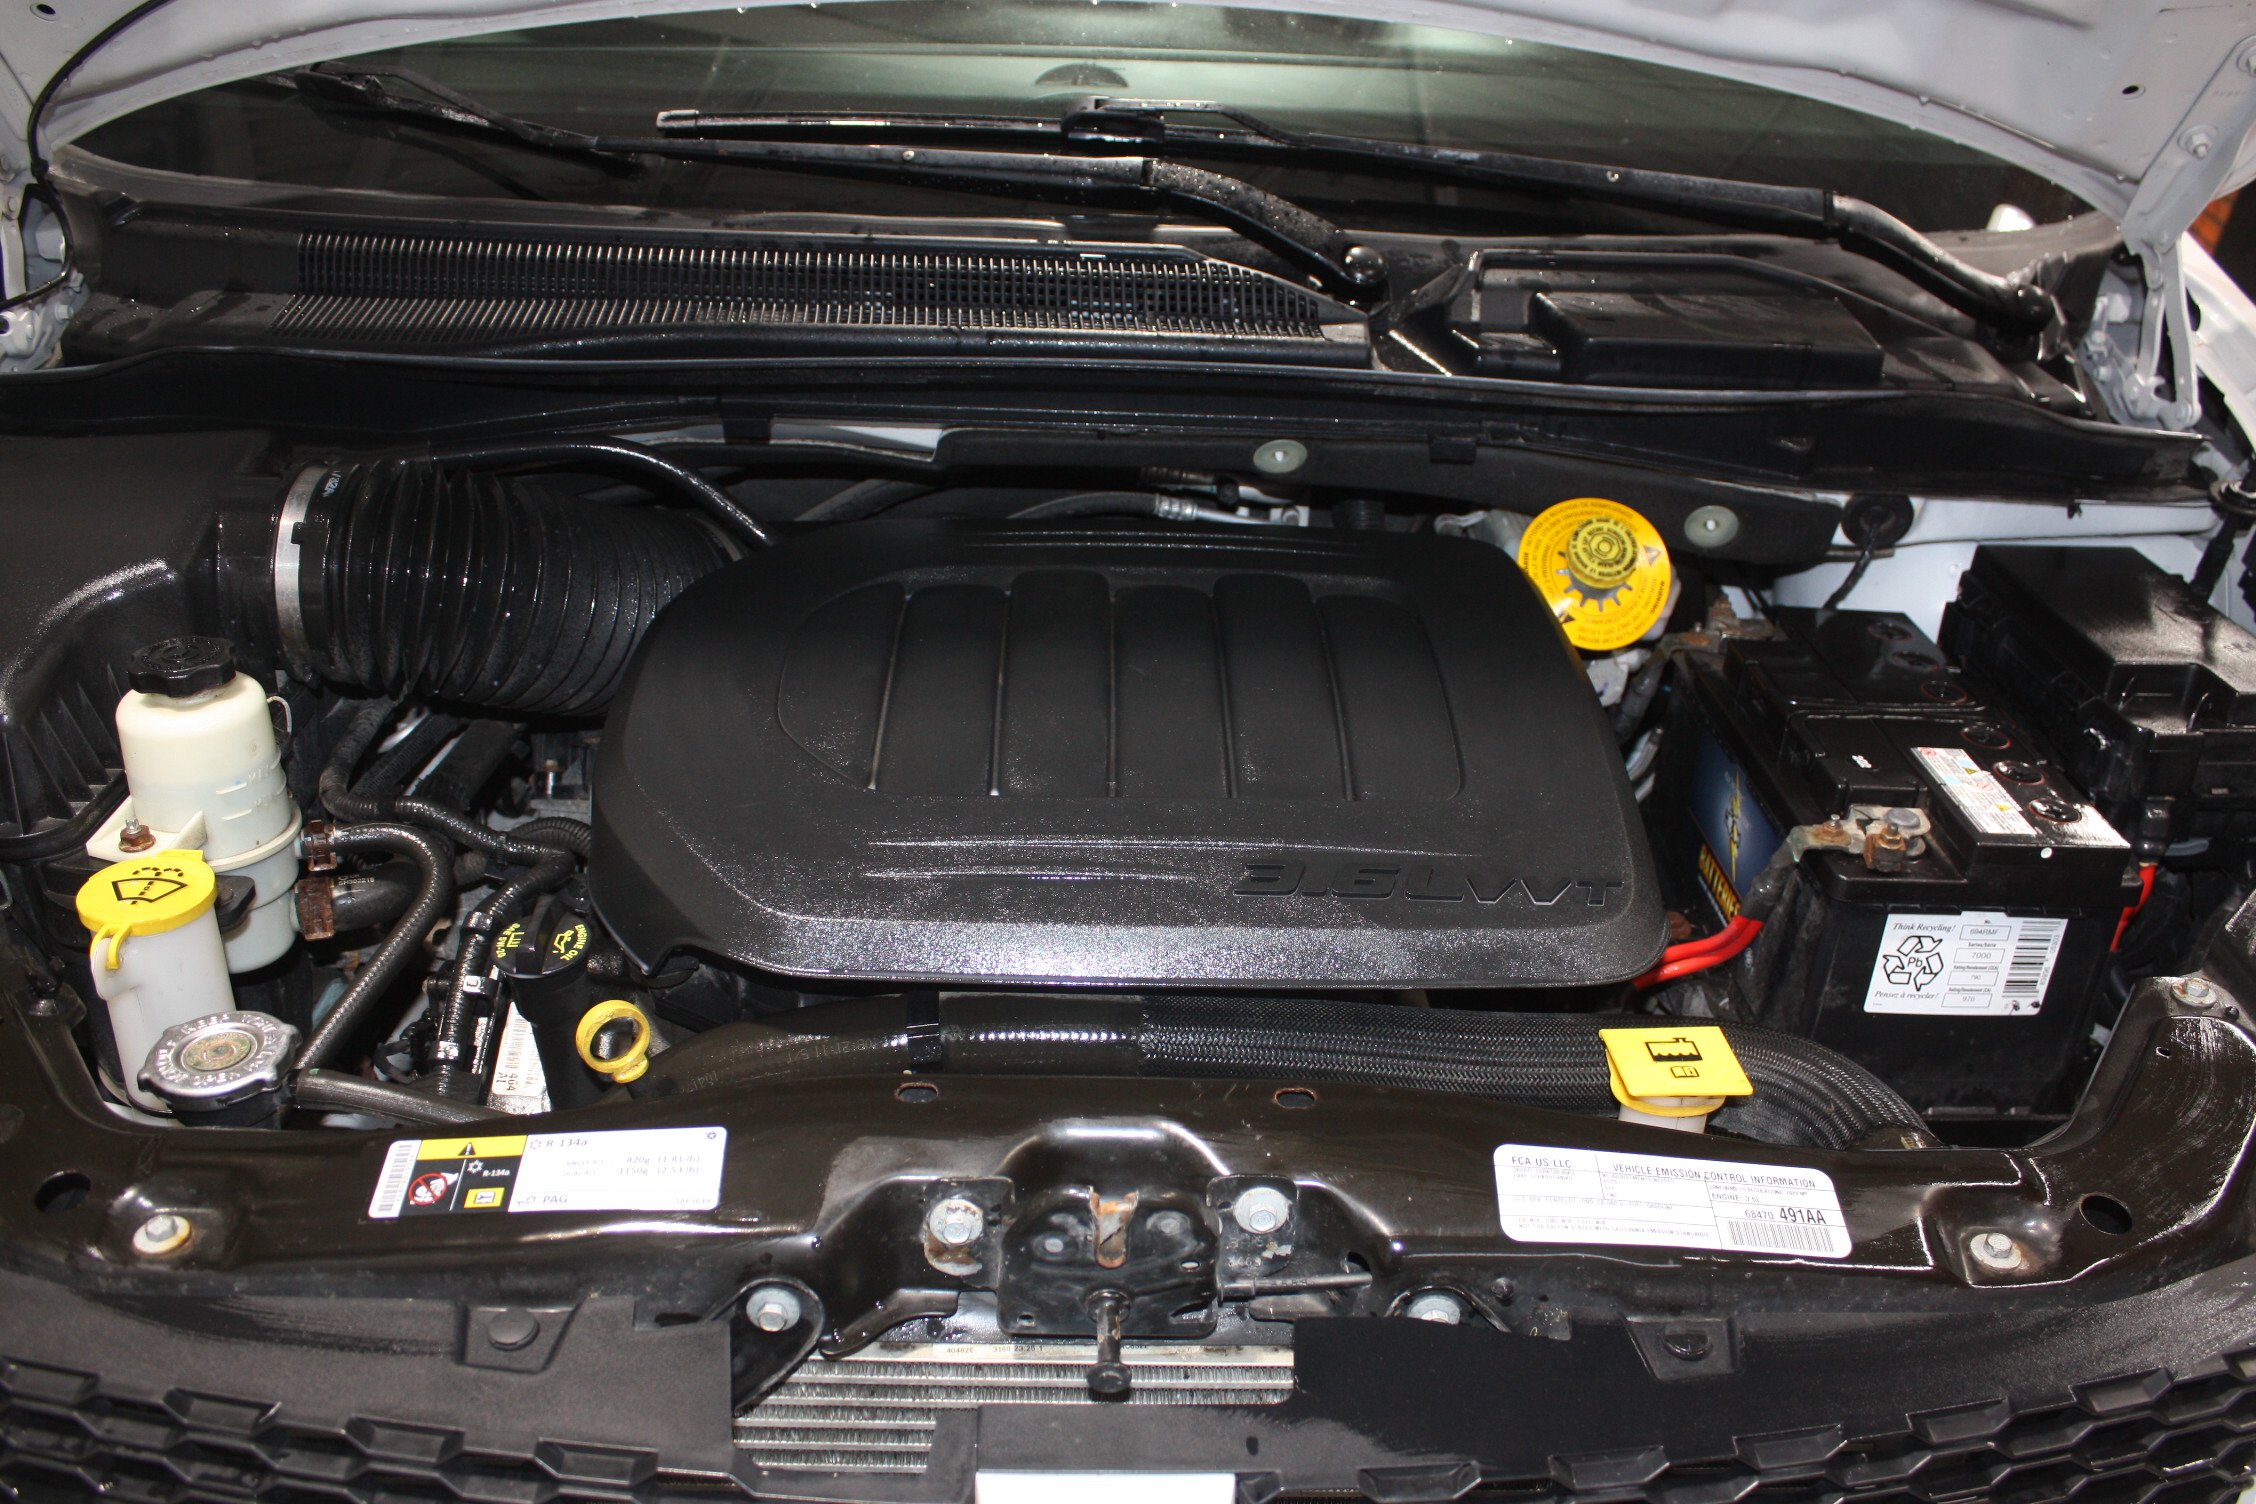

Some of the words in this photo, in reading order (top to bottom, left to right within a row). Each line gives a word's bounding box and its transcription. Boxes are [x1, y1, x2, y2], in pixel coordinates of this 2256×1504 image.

[503, 923, 521, 936] SAE
[1893, 922, 1914, 930] Think
[1916, 923, 1957, 932] Recycling!
[575, 924, 588, 950] ENGINE
[496, 937, 507, 958] 5W-20
[560, 949, 579, 961] OIL
[1907, 956, 1923, 968] Pb
[1874, 990, 1899, 998] Pensez
[1907, 992, 1939, 1000] recycler!
[546, 1139, 588, 1148] R-134a
[1511, 1156, 1531, 1166] FCA
[1535, 1158, 1550, 1167] US
[1553, 1159, 1572, 1169] LLC
[482, 1169, 510, 1177] R-134a
[1613, 1163, 1652, 1175] VEHICLE
[1656, 1166, 1701, 1179] EMISSION
[1703, 1171, 1747, 1183] CONTROL
[1751, 1175, 1816, 1188] INFORMATION
[543, 1195, 568, 1204] PAG
[1744, 1209, 1774, 1220] 68470
[1779, 1207, 1827, 1224] 491AA
